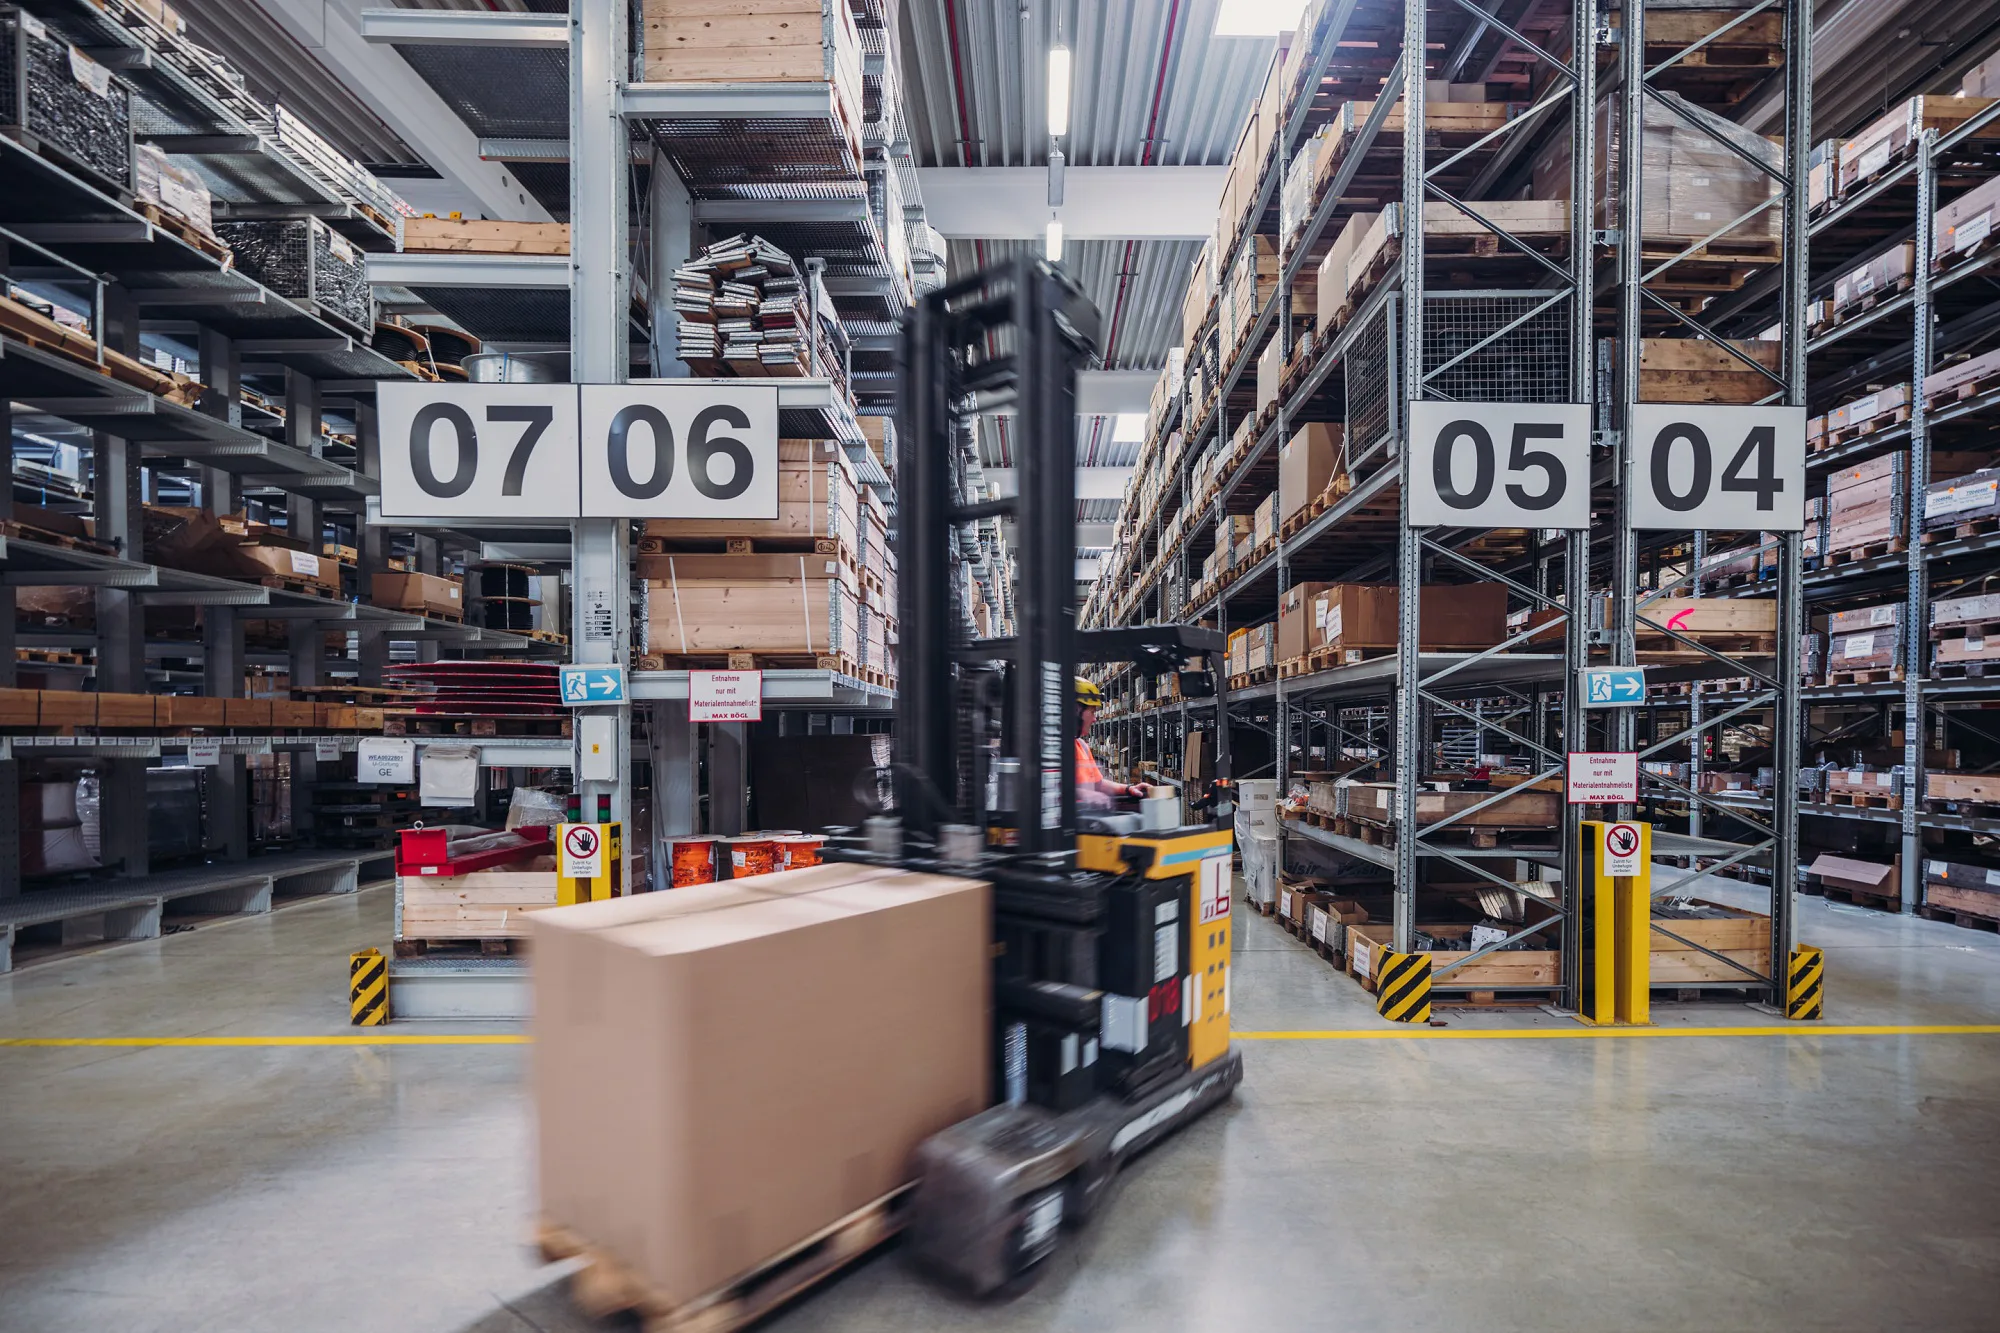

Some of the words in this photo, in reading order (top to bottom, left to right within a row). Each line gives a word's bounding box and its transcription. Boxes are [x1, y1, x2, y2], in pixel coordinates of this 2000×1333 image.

[409, 402, 553, 498] 07
[607, 404, 754, 500] 06
[1432, 420, 1567, 510] 05
[1650, 422, 1784, 511] 04
[711, 674, 740, 682] Entnahme
[378, 768, 392, 776] GE
